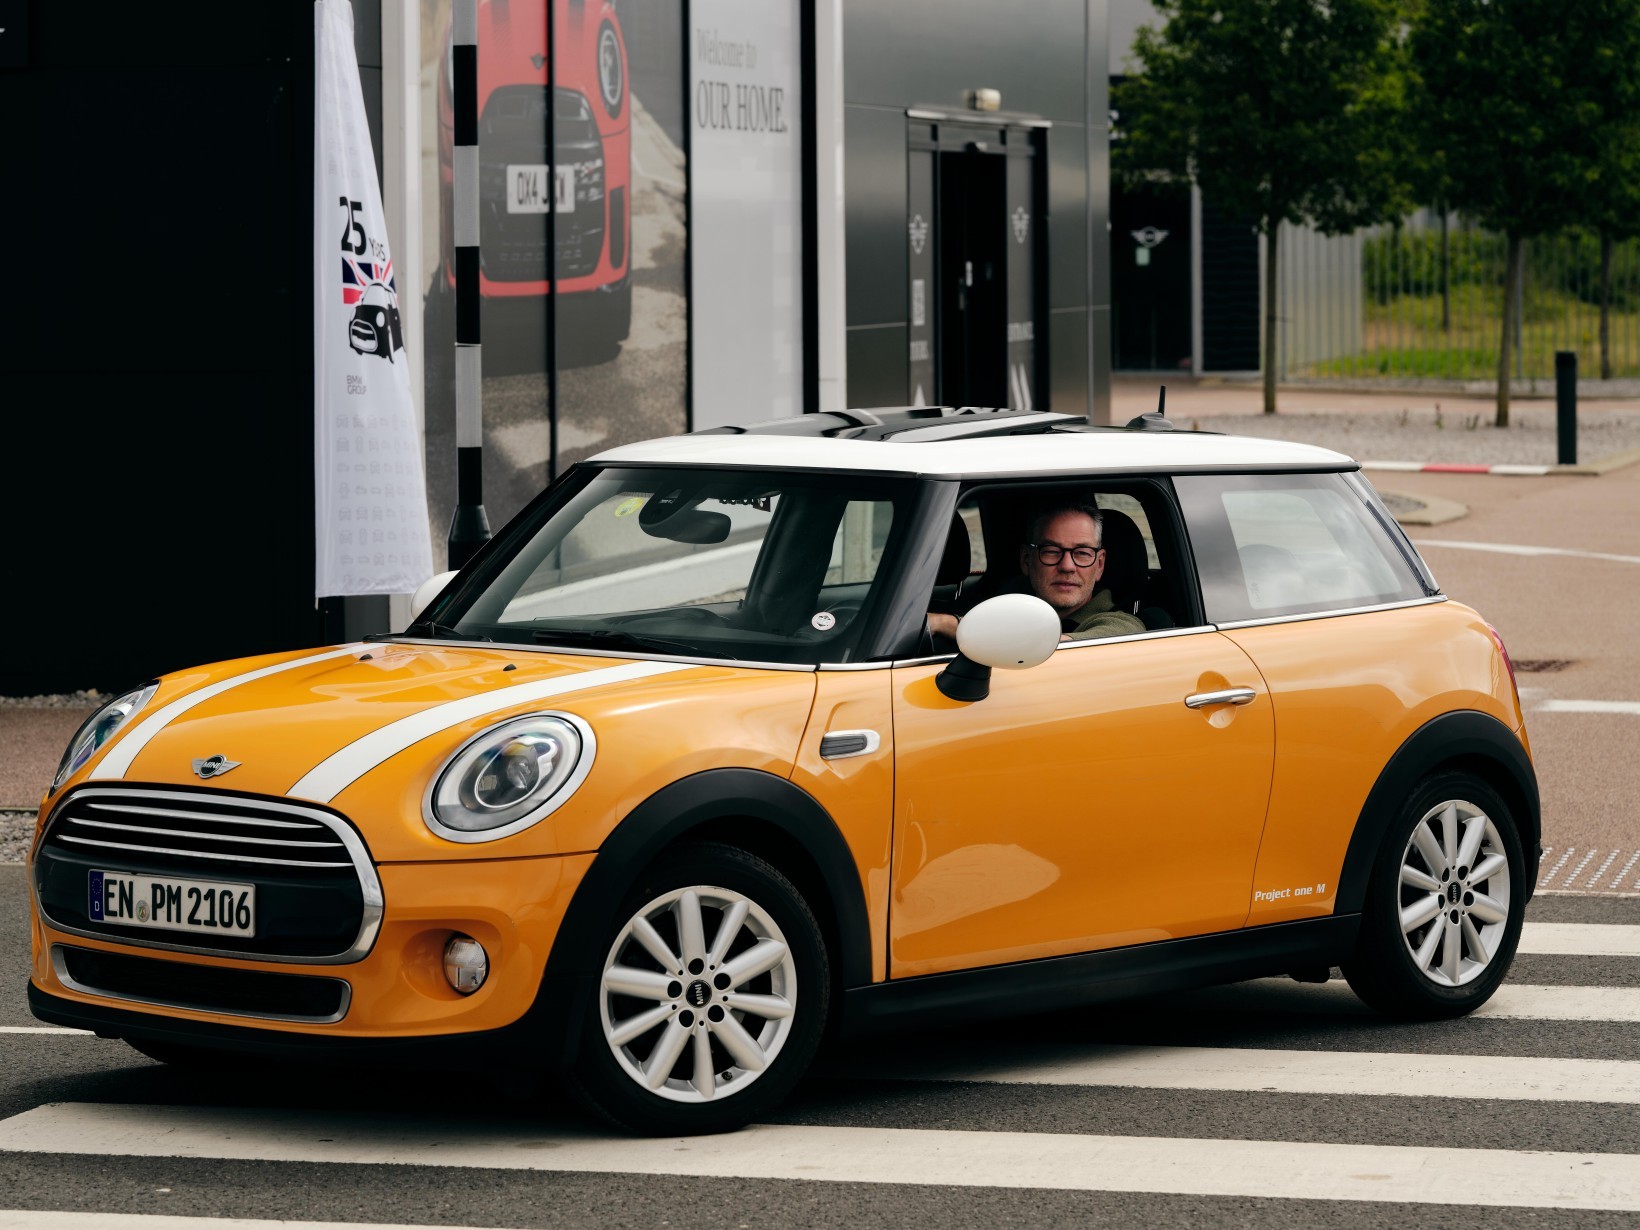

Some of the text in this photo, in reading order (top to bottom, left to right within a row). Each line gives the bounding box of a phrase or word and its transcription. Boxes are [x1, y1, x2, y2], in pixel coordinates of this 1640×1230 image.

[697, 28, 758, 69] Welcome to
[697, 80, 788, 133] OUR HOME.
[339, 196, 367, 256] 25
[203, 761, 221, 770] MINI
[94, 901, 100, 912] D
[104, 878, 251, 930] EN PM 2106
[1254, 883, 1326, 902] Project one M
[694, 983, 704, 1005] MINI
